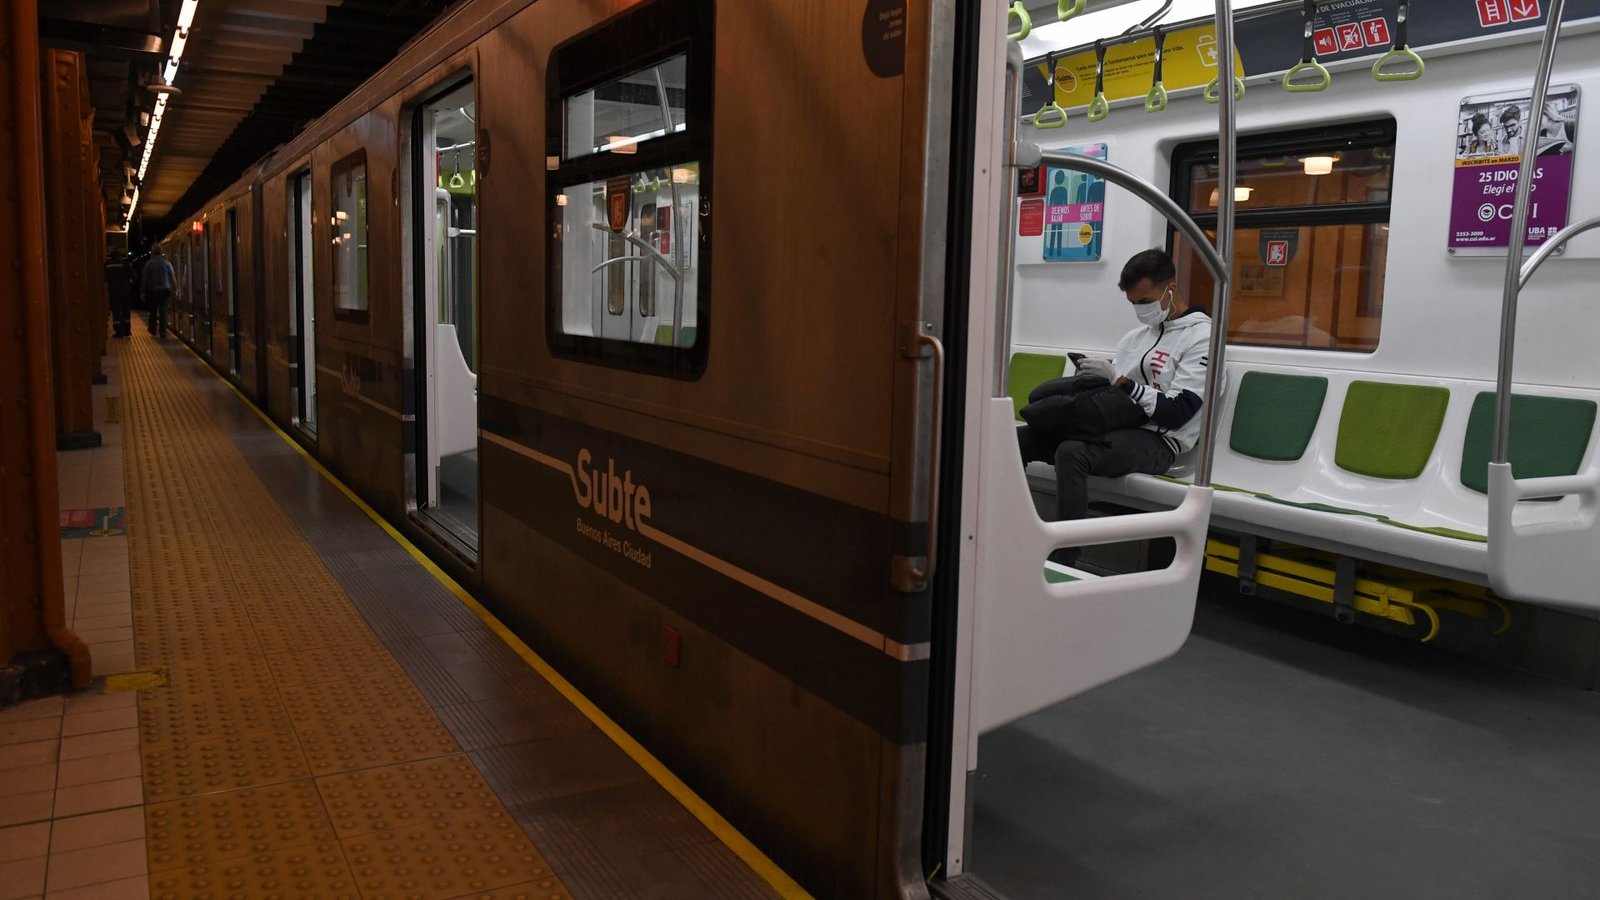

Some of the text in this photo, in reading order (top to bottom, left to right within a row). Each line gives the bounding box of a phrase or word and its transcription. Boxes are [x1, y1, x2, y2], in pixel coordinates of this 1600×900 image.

[1478, 168, 1544, 182] 25 IDIOS
[1505, 182, 1515, 193] el
[1051, 205, 1070, 215] DEJEMOS
[1497, 203, 1538, 220] CI
[1528, 226, 1546, 234] UBA
[574, 447, 652, 535] Subte
[576, 516, 651, 569] Buenos Aires Ciudad
